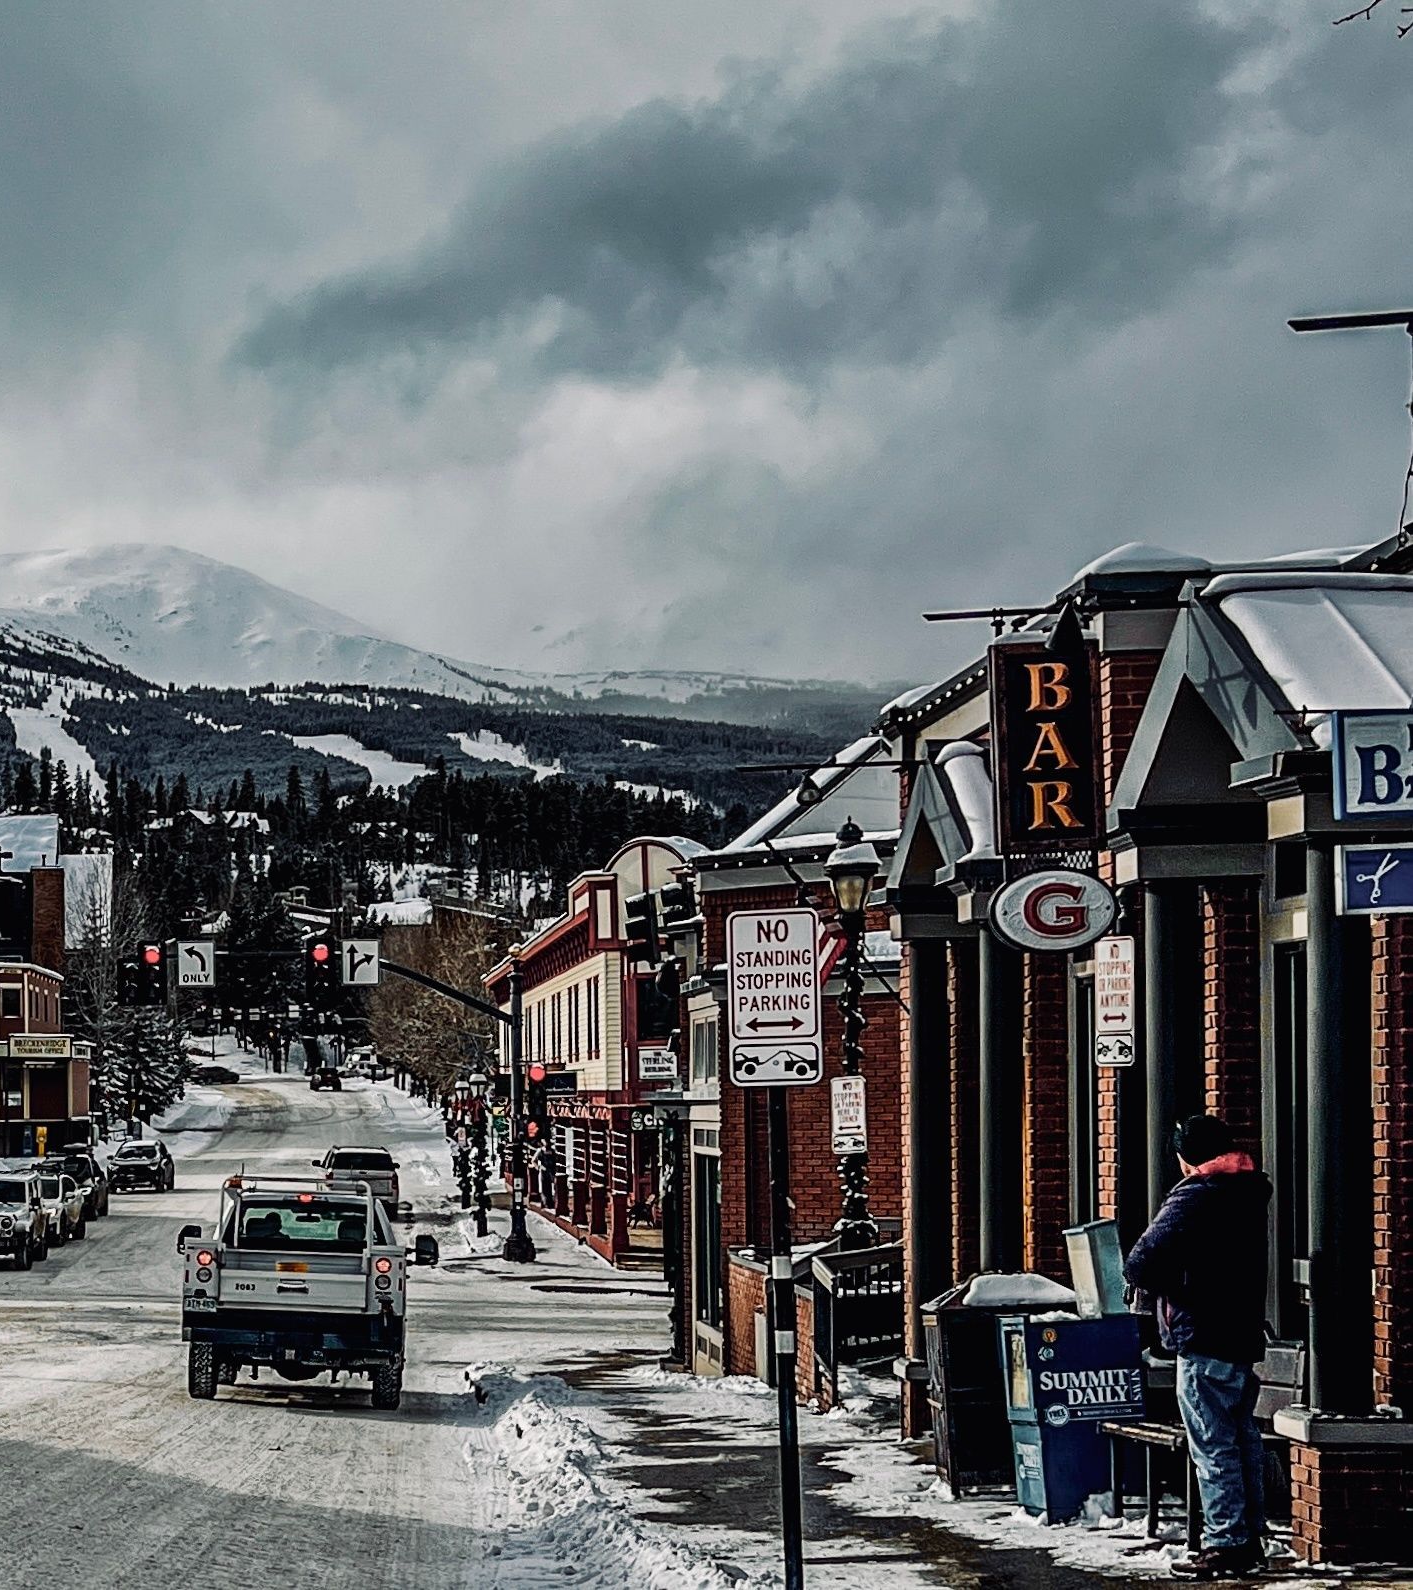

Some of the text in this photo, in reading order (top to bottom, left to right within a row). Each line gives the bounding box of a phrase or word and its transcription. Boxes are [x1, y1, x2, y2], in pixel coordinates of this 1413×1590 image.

[1023, 662, 1085, 830] BAR
[1354, 743, 1413, 805] B
[1022, 881, 1089, 939] G
[757, 919, 789, 943] NO
[736, 949, 812, 967] STANDING
[1099, 960, 1131, 976] STOPPING
[182, 973, 210, 983] ONLY
[736, 971, 812, 990] STOPPING
[1108, 976, 1131, 991] PARKING
[739, 994, 810, 1012] PARKING
[1100, 993, 1129, 1008] ANYTIME
[843, 1082, 852, 1091] NO
[1040, 1369, 1129, 1391] SUMMIT
[1066, 1386, 1128, 1405] DAILY
